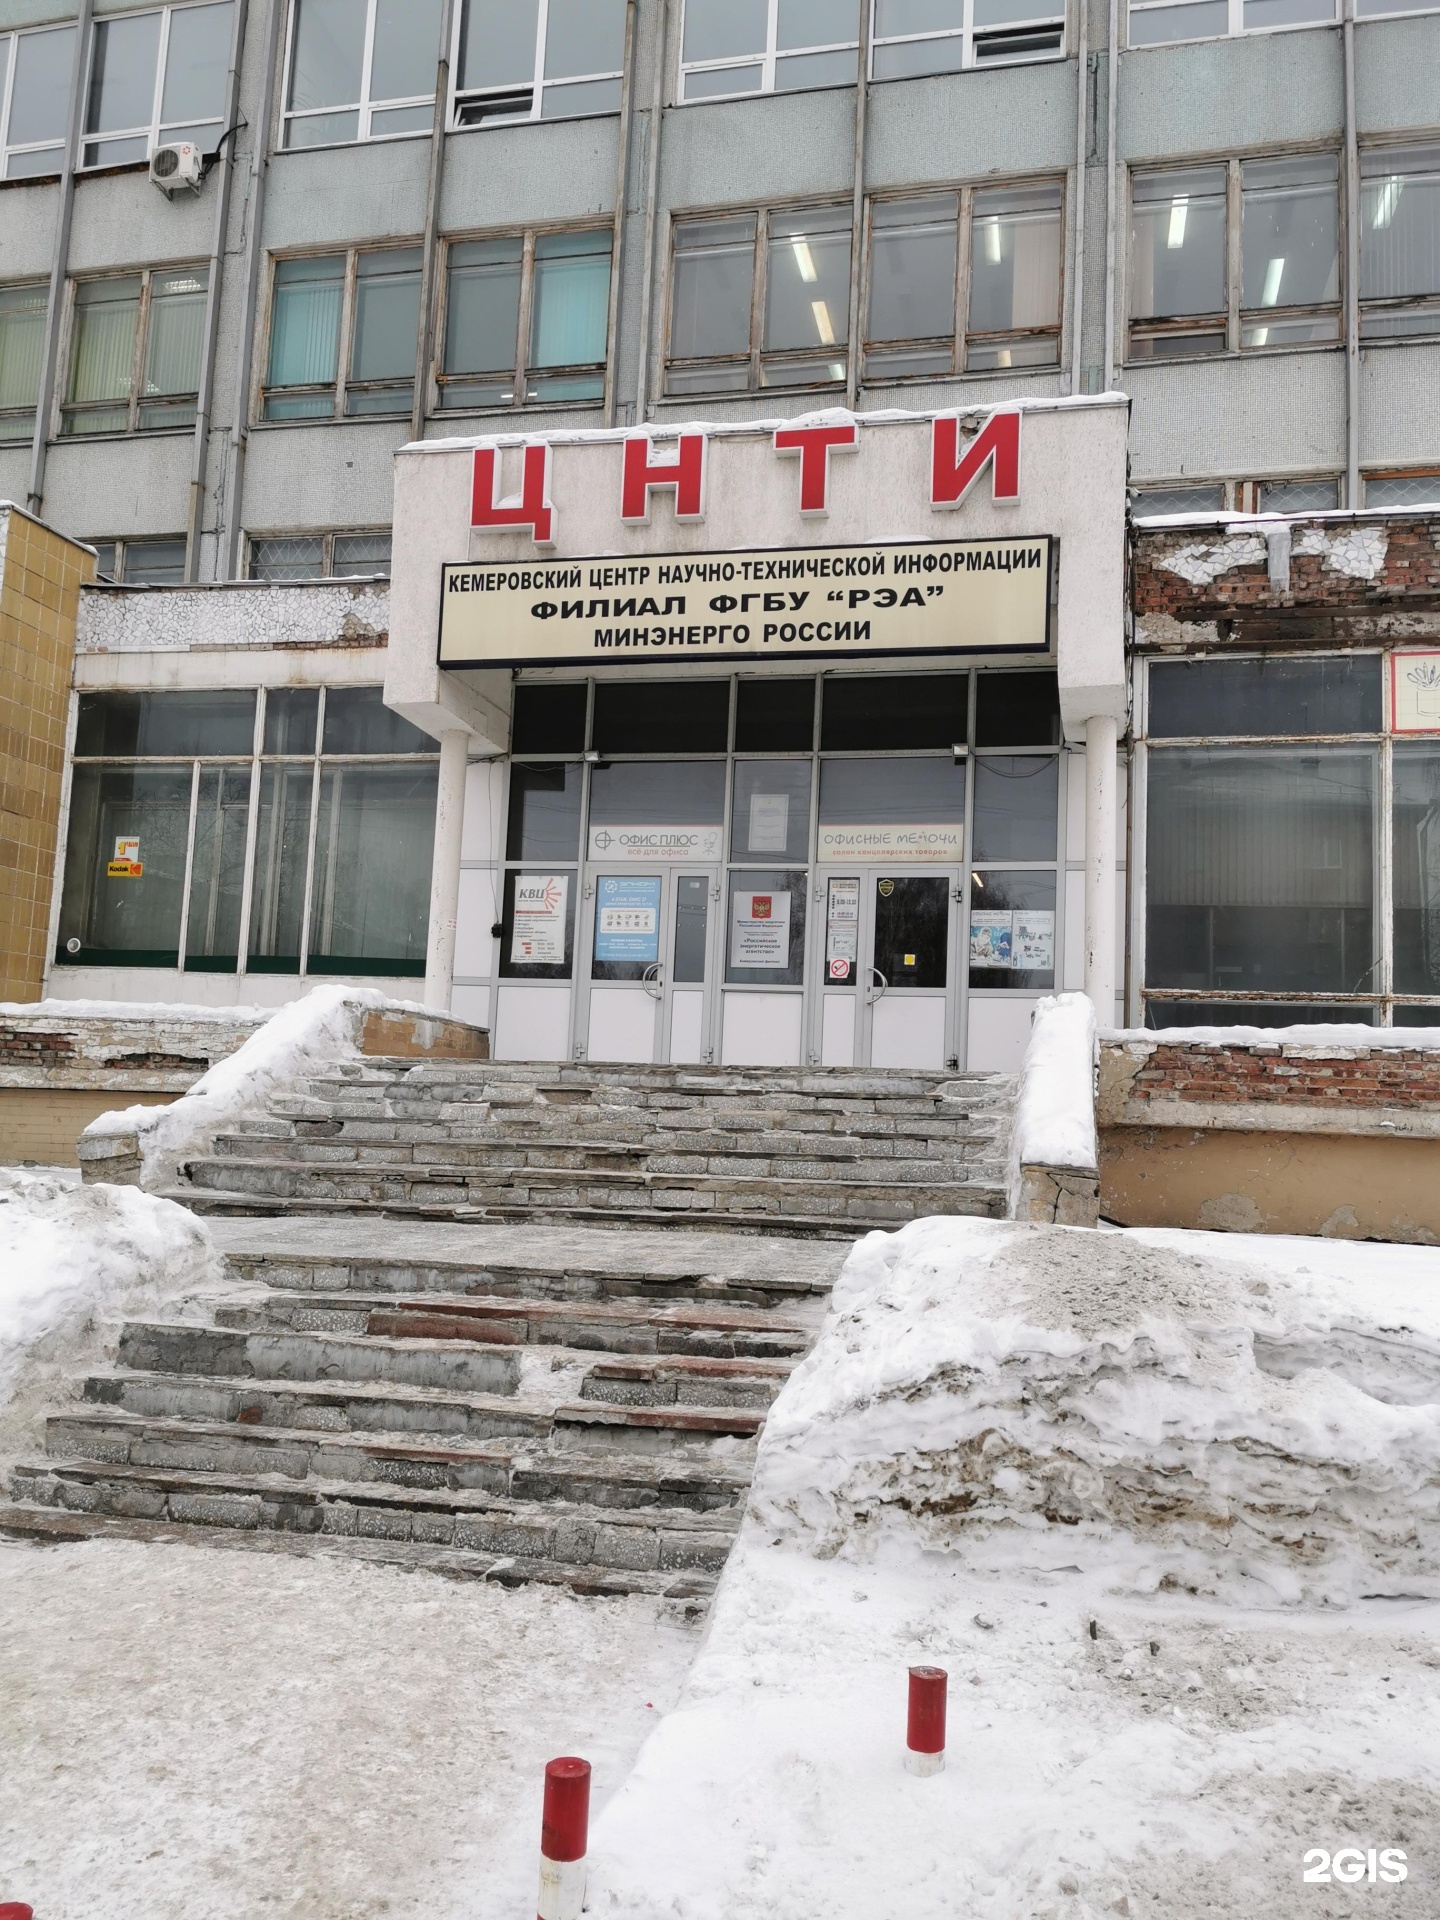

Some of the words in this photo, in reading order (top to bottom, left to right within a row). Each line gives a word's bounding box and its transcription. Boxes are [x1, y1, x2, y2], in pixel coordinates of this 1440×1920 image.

[470, 412, 1022, 547] ЦНТИ
[449, 565, 582, 593] КЕМЕРОВСКИЙ
[589, 566, 650, 591] ЦЕНТР
[658, 551, 885, 584] НАУЧНО-ТЕХНИЧЕСКОЙ
[894, 548, 1042, 575] ИНФОРМАЦИИ
[530, 595, 687, 620] ФИЛИАЛ
[709, 591, 810, 613] ФГБУ
[594, 624, 750, 648] МИНЭНЕРГО
[763, 620, 871, 643] РОССИИ
[619, 834, 658, 846] ОФИС
[659, 834, 699, 846] ПЛЮС
[823, 832, 892, 846] ОФИСНЫЕ
[643, 848, 659, 856] для
[660, 848, 689, 857] офиса
[857, 848, 913, 857] канцелярских
[915, 848, 948, 857] товаров
[518, 888, 546, 899] КВЦ
